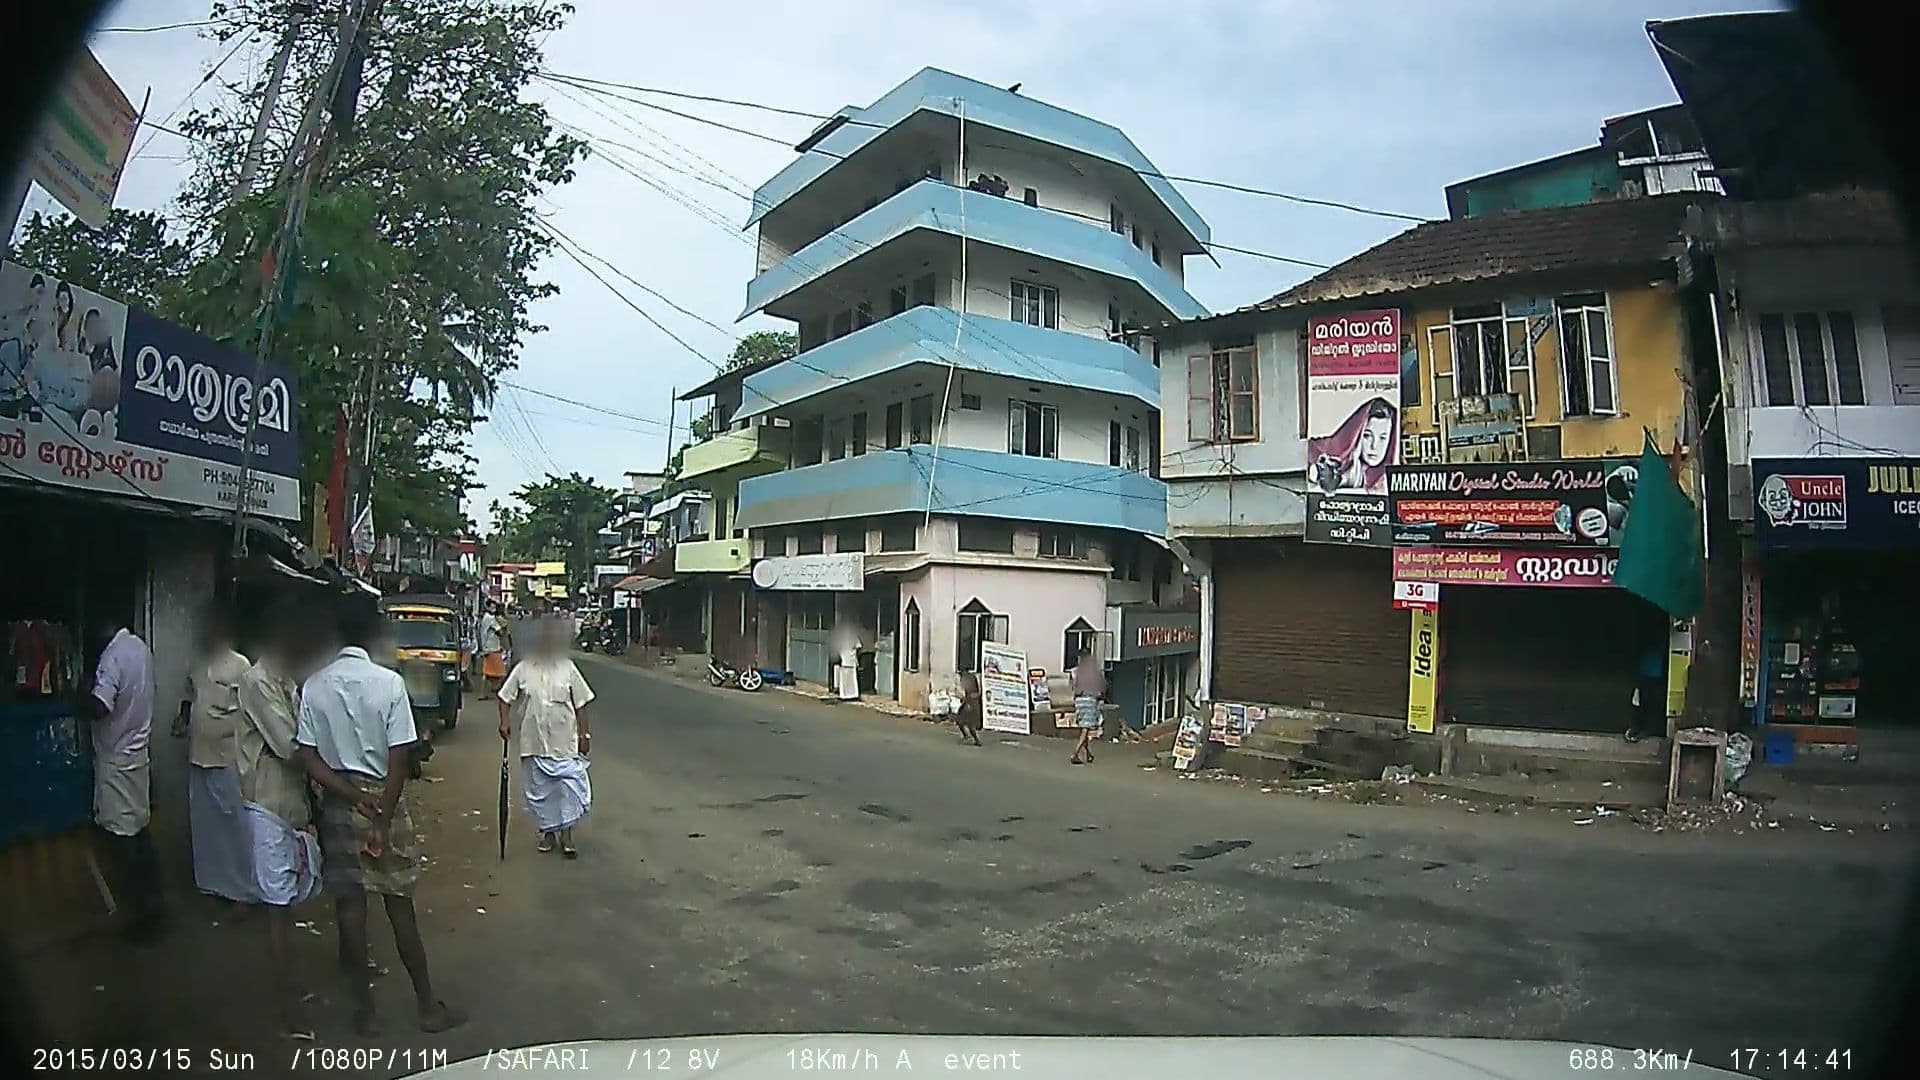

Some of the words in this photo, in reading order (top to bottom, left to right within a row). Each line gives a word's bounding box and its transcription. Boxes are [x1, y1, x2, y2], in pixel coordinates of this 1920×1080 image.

[1315, 316, 1393, 339] മരിയൻ
[1391, 472, 1447, 492] MARIYAN
[1448, 471, 1499, 496] Digital
[1501, 470, 1550, 491] Studio
[1552, 469, 1604, 491] World
[1801, 481, 1842, 496] Uncle
[1803, 502, 1843, 519] JOHN
[1407, 584, 1424, 597] 3G
